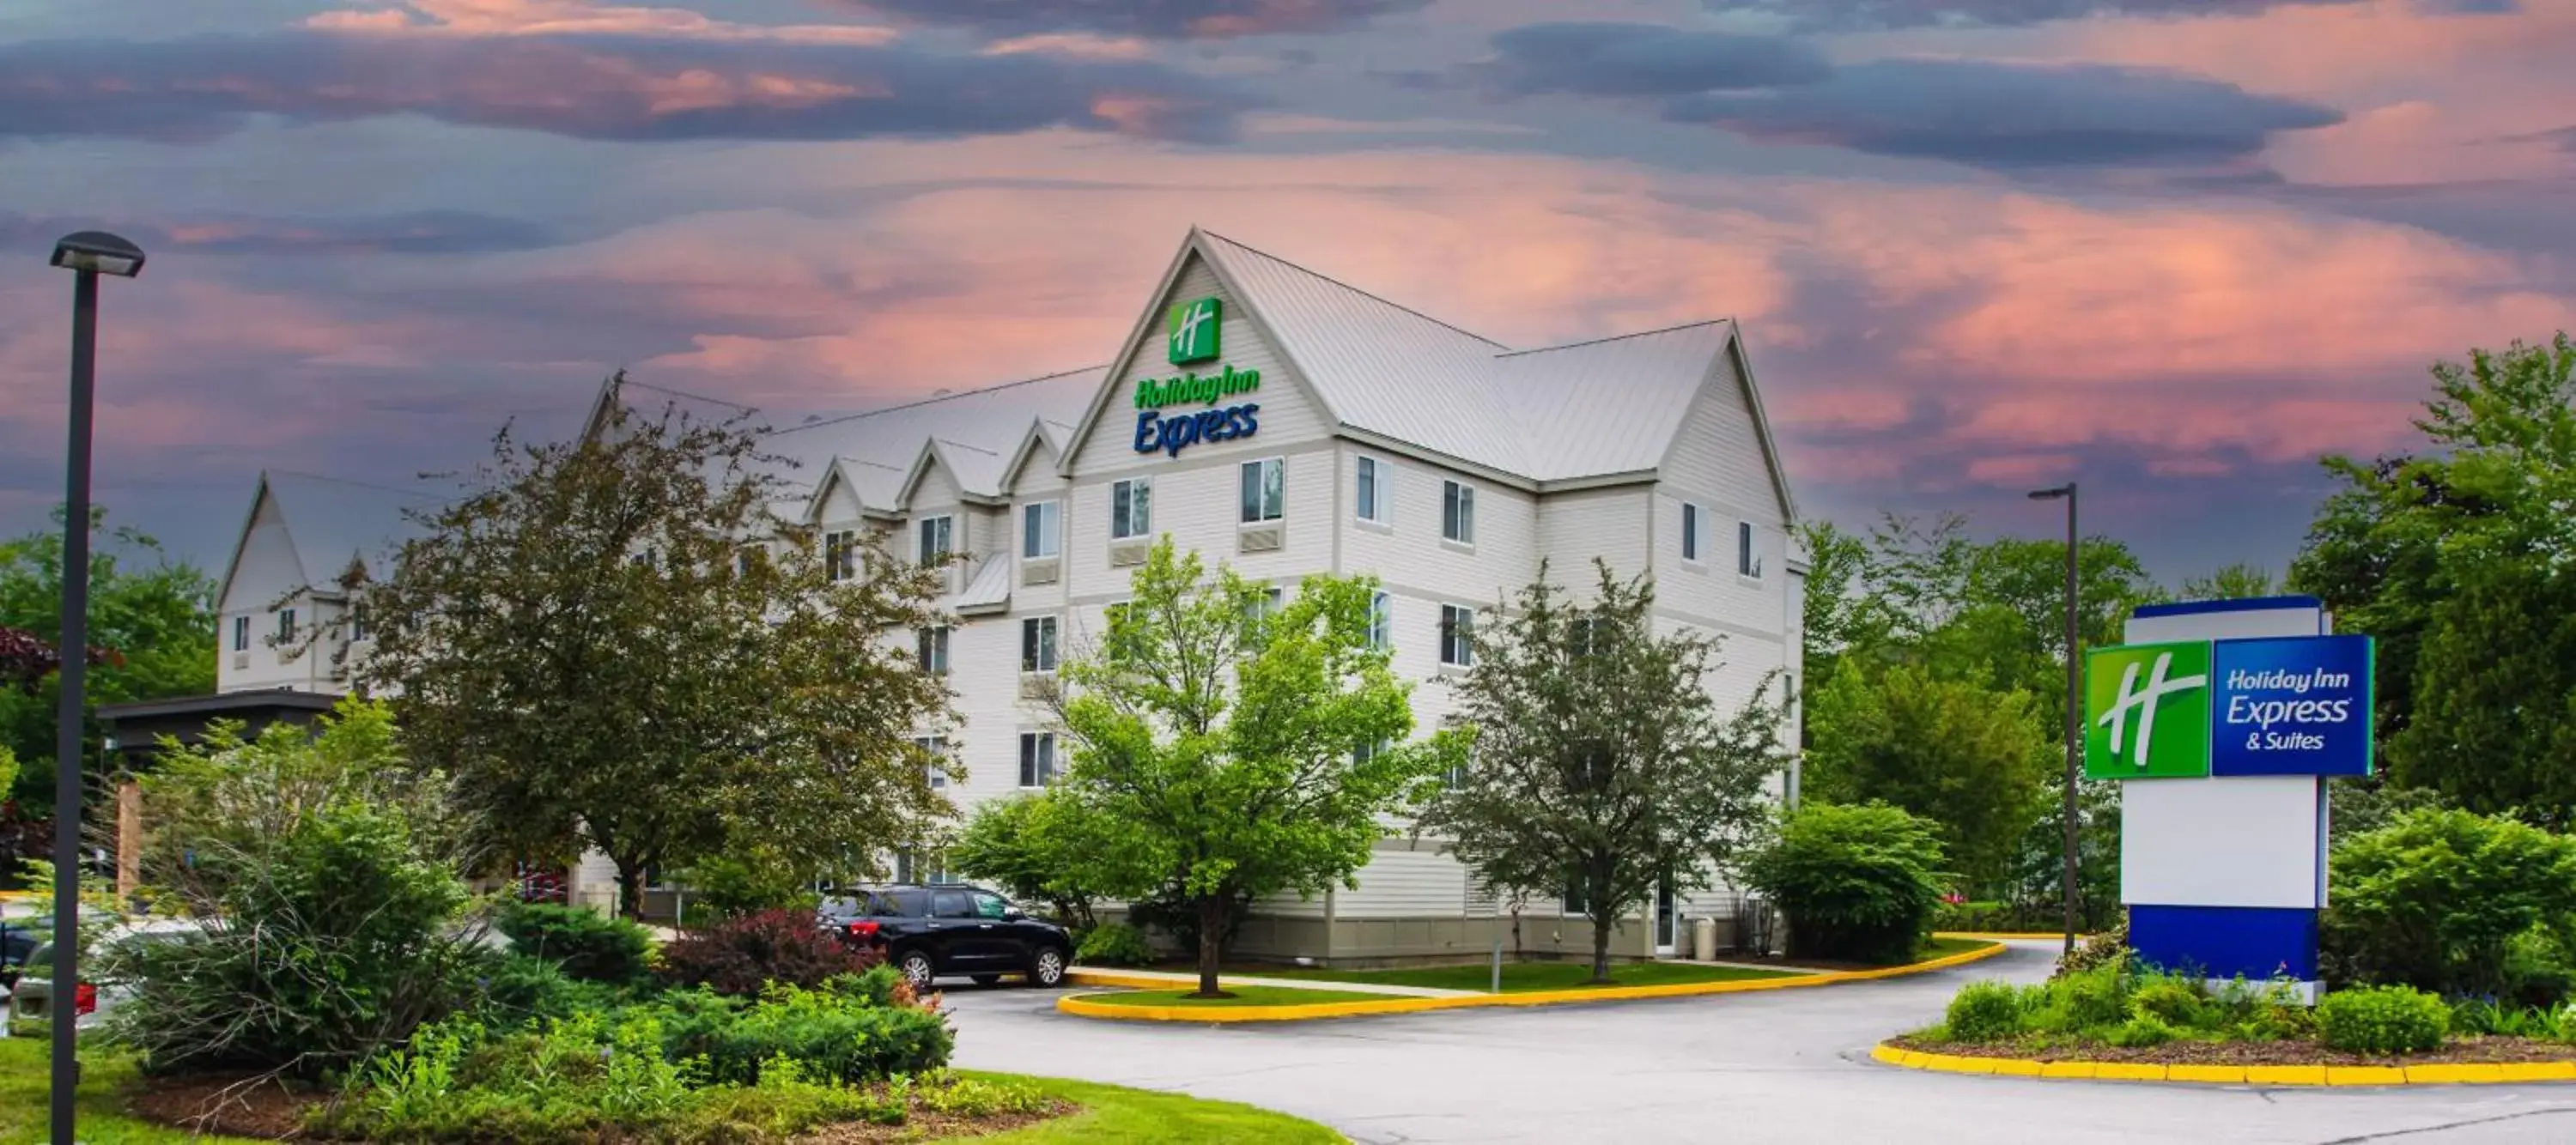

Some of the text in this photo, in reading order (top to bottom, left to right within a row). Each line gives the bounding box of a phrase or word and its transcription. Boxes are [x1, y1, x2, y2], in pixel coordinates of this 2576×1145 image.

[1133, 364, 1261, 409] Holiday Inn
[1133, 403, 1261, 458] Express
[2227, 667, 2350, 694] Holiday Inn
[2098, 651, 2207, 766] H
[2227, 694, 2350, 730] Express
[2245, 731, 2325, 750] & Suites
